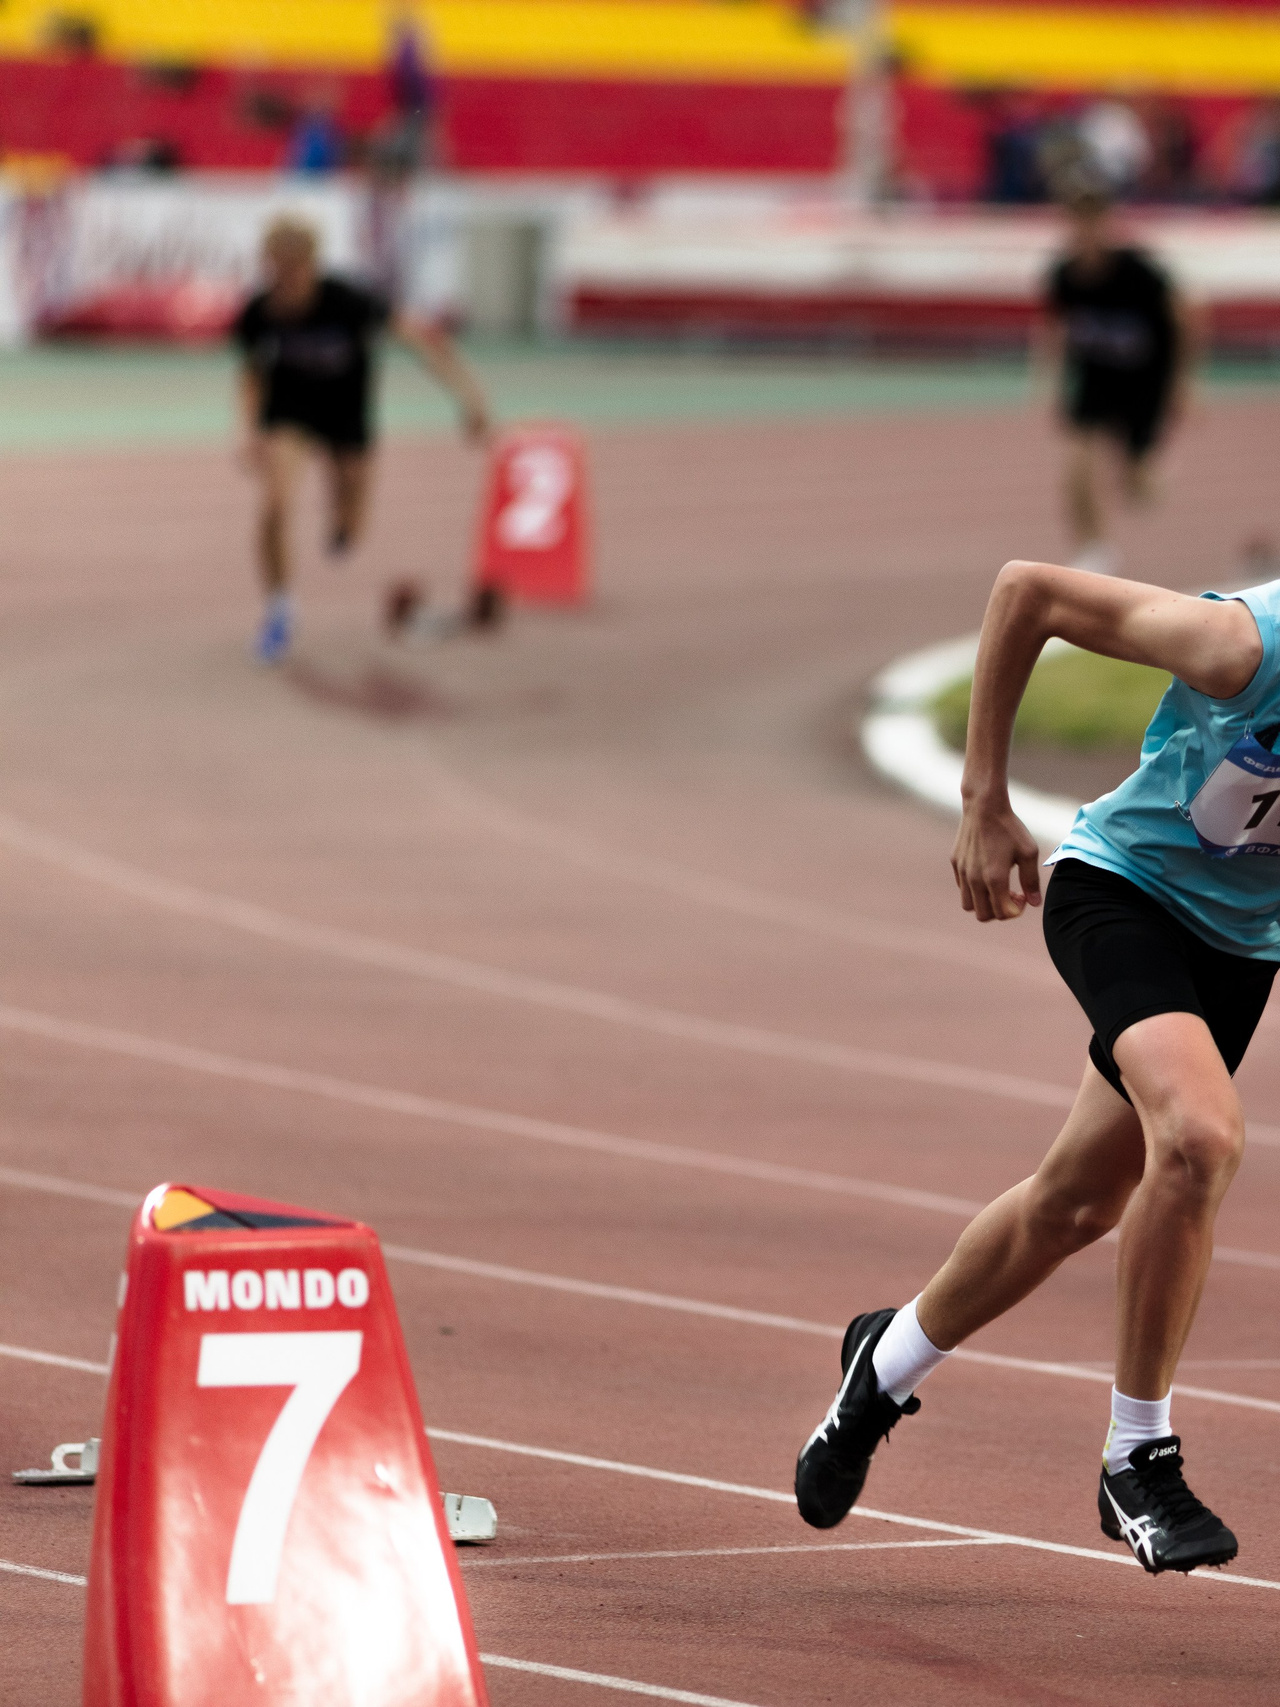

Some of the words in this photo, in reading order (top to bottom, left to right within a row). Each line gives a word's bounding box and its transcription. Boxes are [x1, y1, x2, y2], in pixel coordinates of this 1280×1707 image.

[499, 449, 570, 548] 2
[184, 1268, 370, 1311] MONDO
[197, 1330, 363, 1605] 7
[1158, 1444, 1178, 1457] asics
